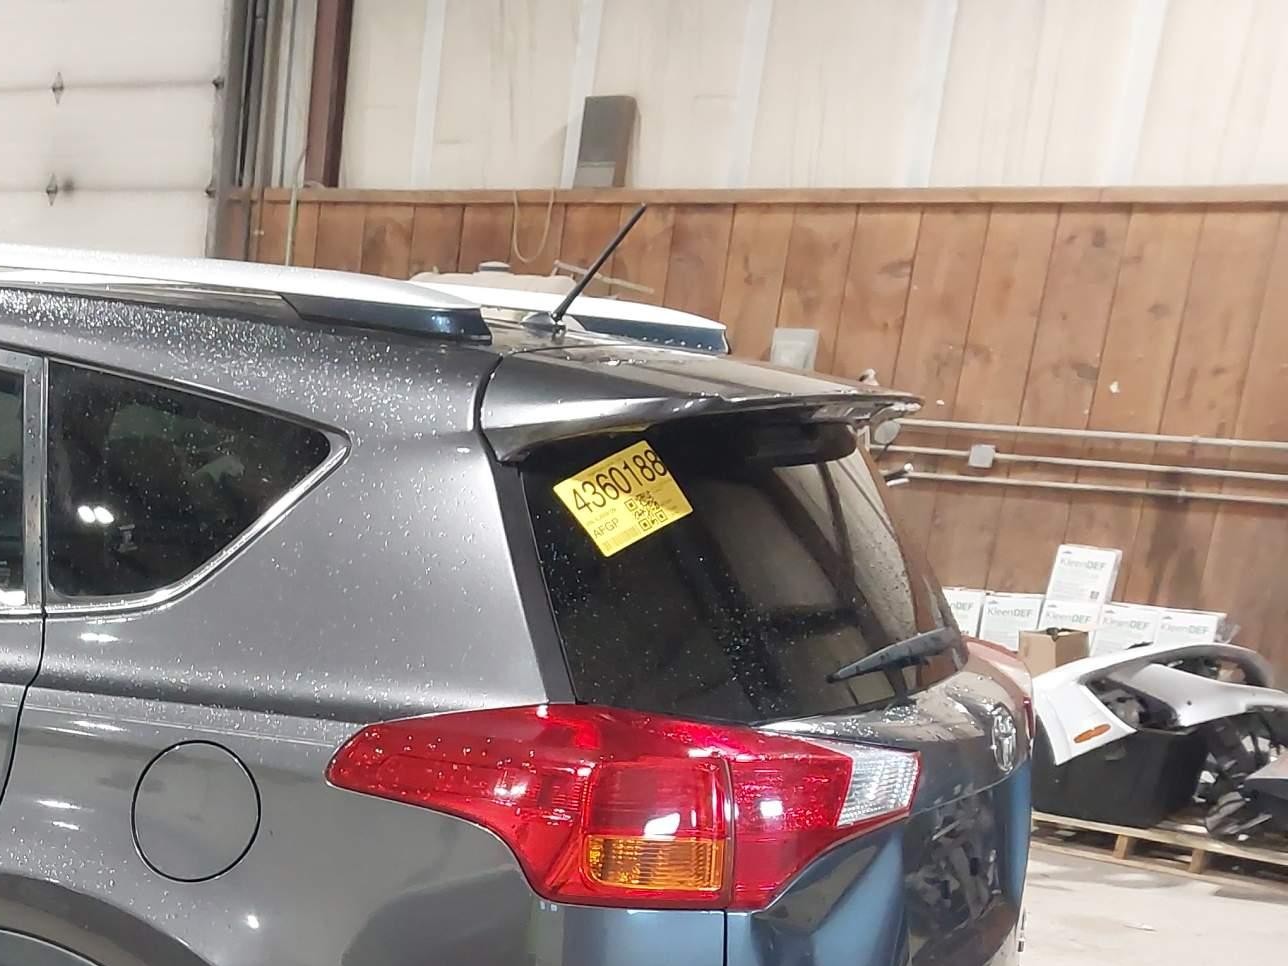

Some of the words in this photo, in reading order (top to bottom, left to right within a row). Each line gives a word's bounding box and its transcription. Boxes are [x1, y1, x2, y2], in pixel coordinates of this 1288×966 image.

[572, 448, 668, 513] 4360188
[1060, 557, 1106, 570] KleenDEF
[987, 607, 1033, 618] KleenDEF
[1046, 612, 1092, 623] KleenDEF
